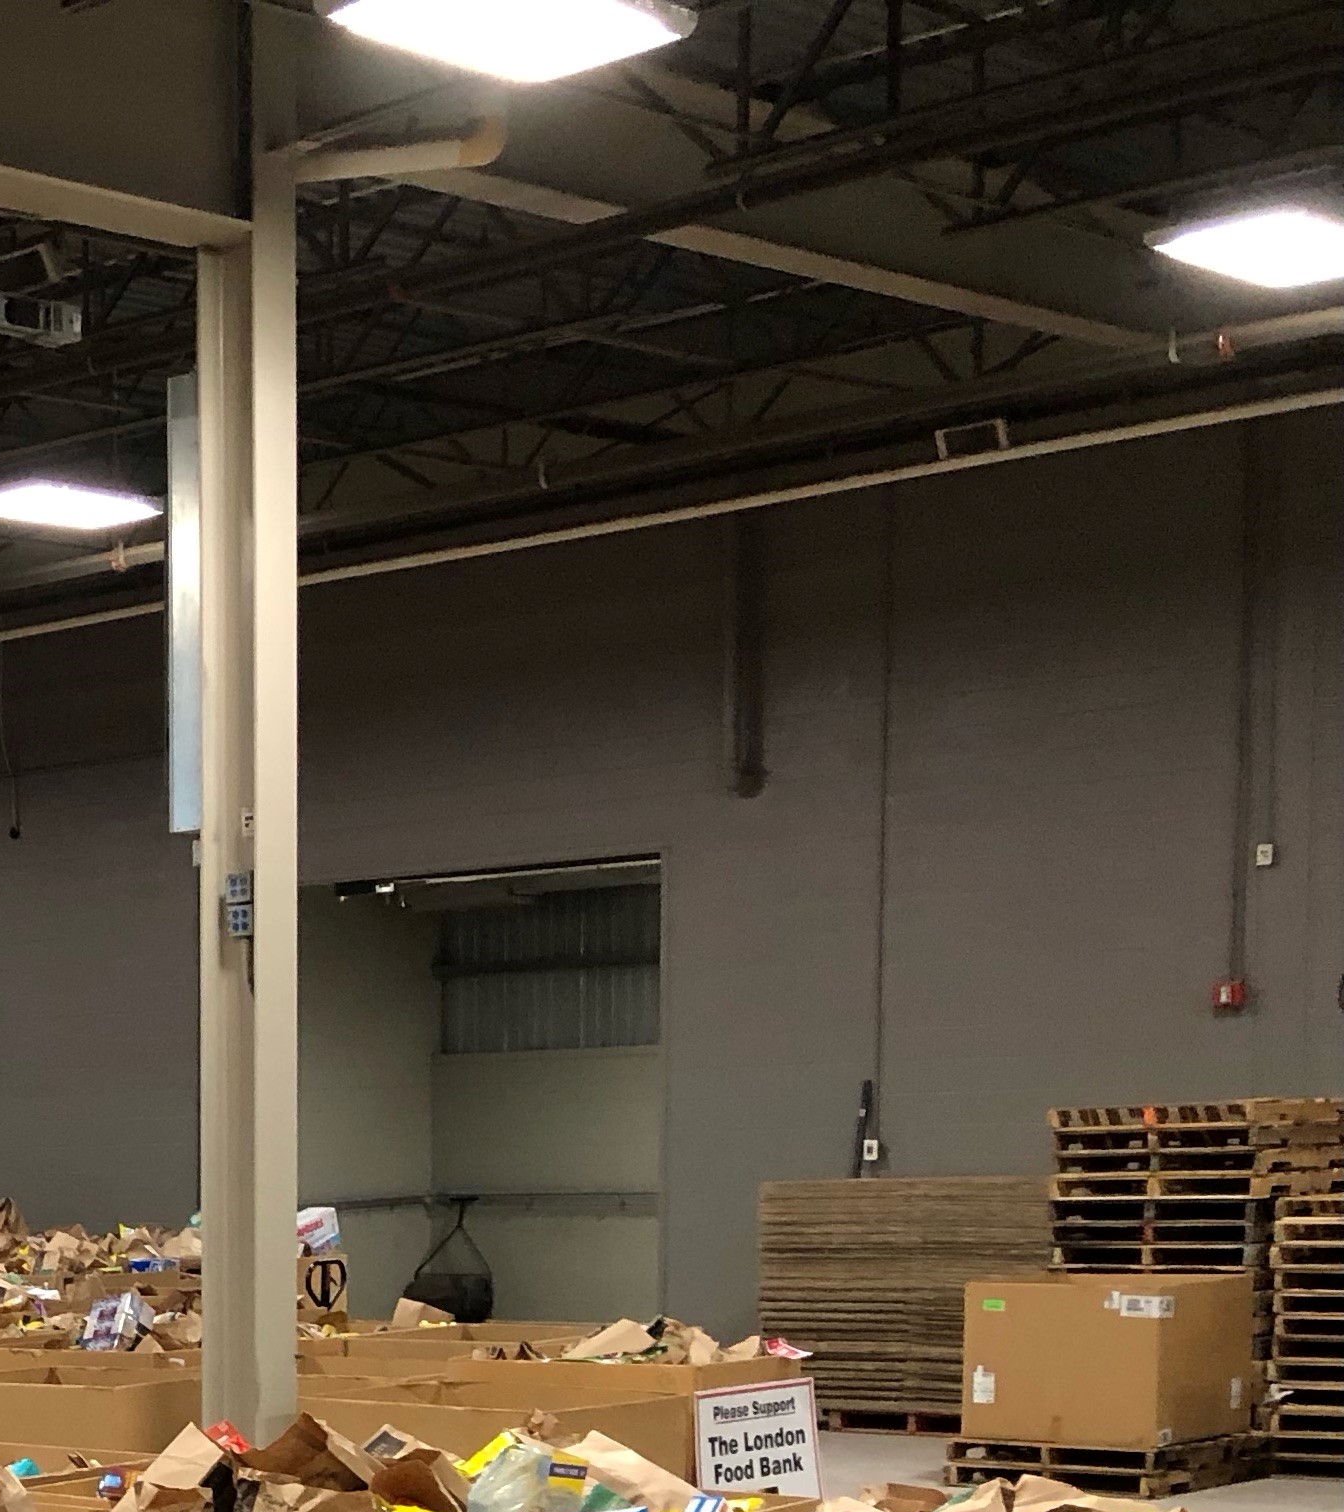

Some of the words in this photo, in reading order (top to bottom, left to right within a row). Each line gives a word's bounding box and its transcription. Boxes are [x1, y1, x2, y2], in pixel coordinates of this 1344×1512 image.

[713, 1404, 749, 1421] Please
[752, 1397, 795, 1417] Support
[708, 1436, 739, 1457] The
[743, 1427, 806, 1452] London
[714, 1460, 754, 1485] Food
[759, 1453, 804, 1477] Bank
